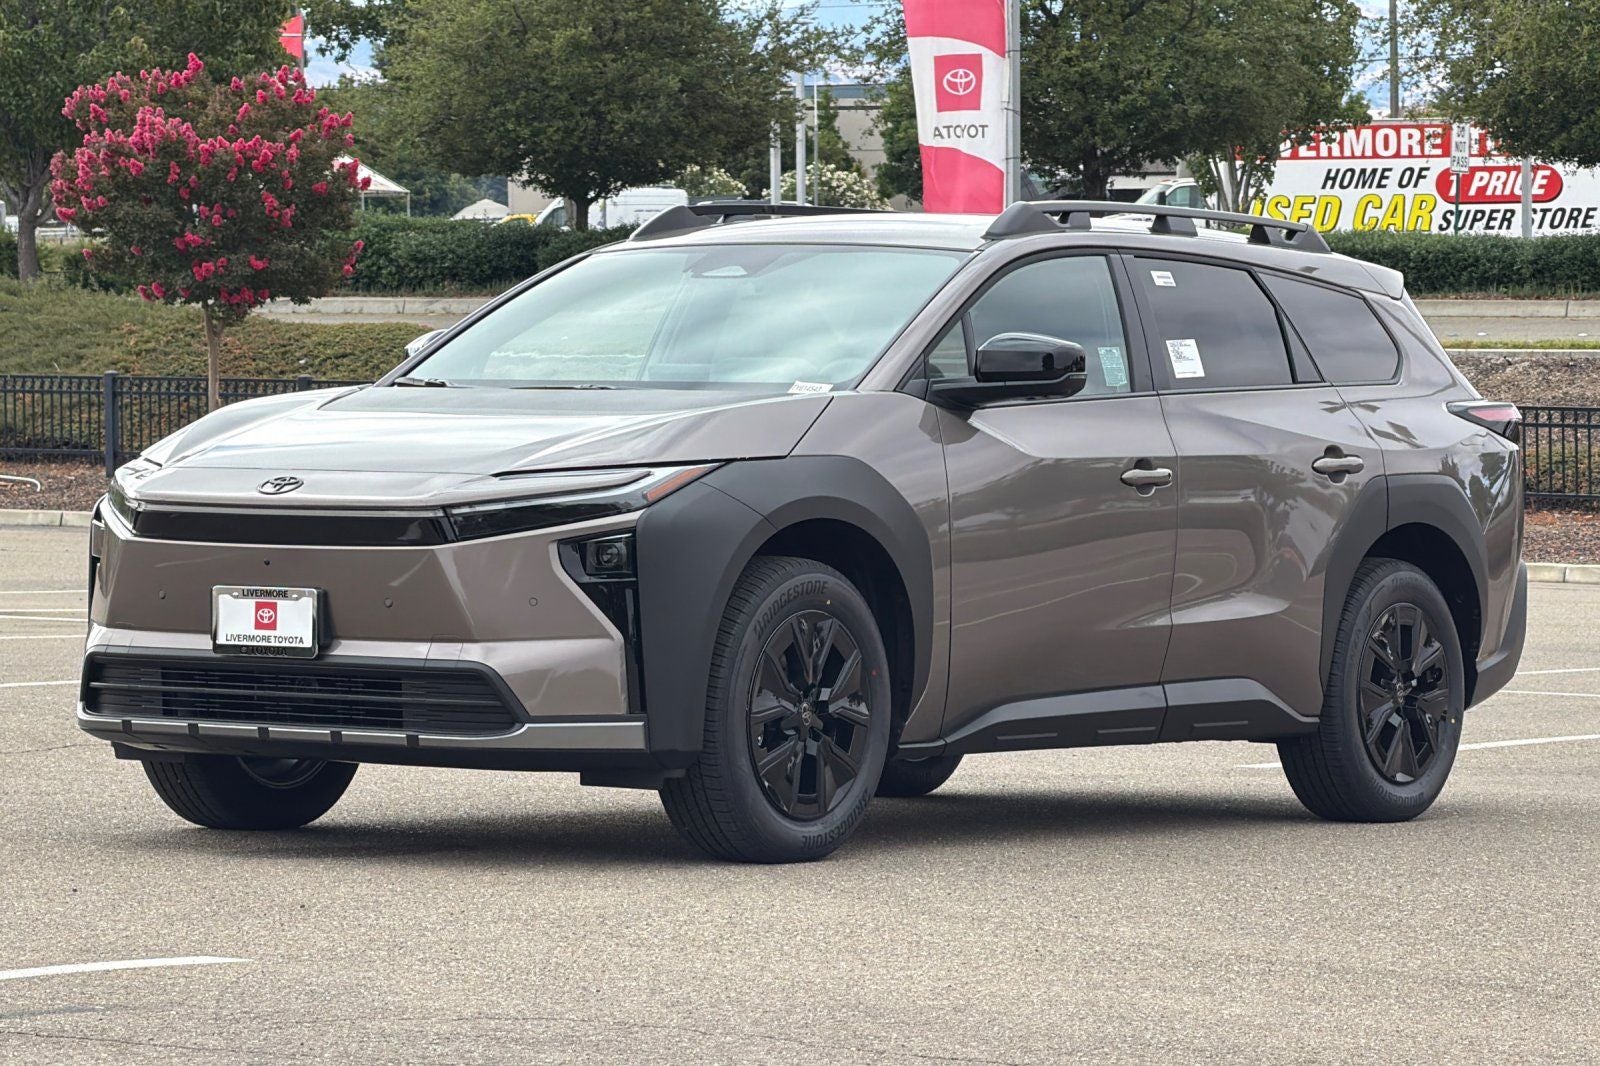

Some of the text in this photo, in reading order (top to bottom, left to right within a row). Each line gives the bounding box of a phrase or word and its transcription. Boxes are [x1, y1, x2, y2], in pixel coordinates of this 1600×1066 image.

[1452, 155, 1468, 168] PASS
[1321, 167, 1431, 190] HOME OF
[1353, 194, 1437, 232] CAR
[1438, 208, 1516, 232] SUPER
[242, 589, 289, 598] LIVERMORE
[754, 580, 829, 640] BRIDGESTONE
[225, 633, 304, 645] LIVERMORE TOYOTA
